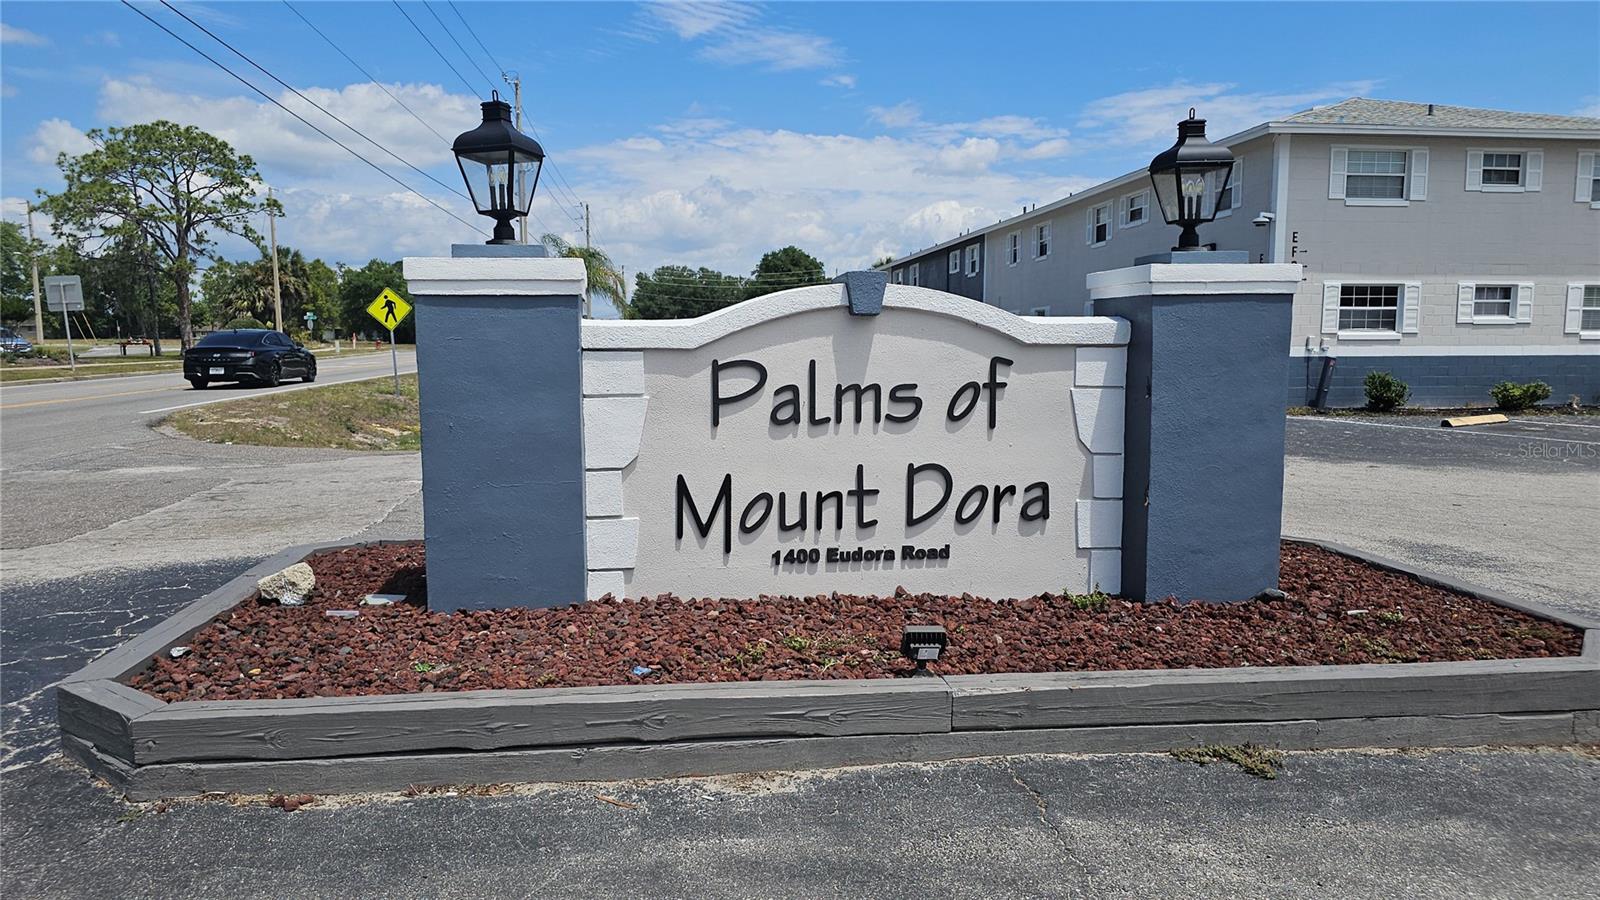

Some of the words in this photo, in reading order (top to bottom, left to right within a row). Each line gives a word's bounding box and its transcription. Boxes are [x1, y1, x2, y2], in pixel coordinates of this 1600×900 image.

[1292, 232, 1298, 243] E
[1292, 246, 1298, 257] F
[711, 359, 923, 427] Palms
[946, 356, 1014, 429] of
[676, 463, 879, 554] Mount
[906, 462, 1050, 528] Dora
[771, 548, 820, 566] 1400
[826, 546, 895, 563] Eudora
[901, 544, 950, 561] Road
